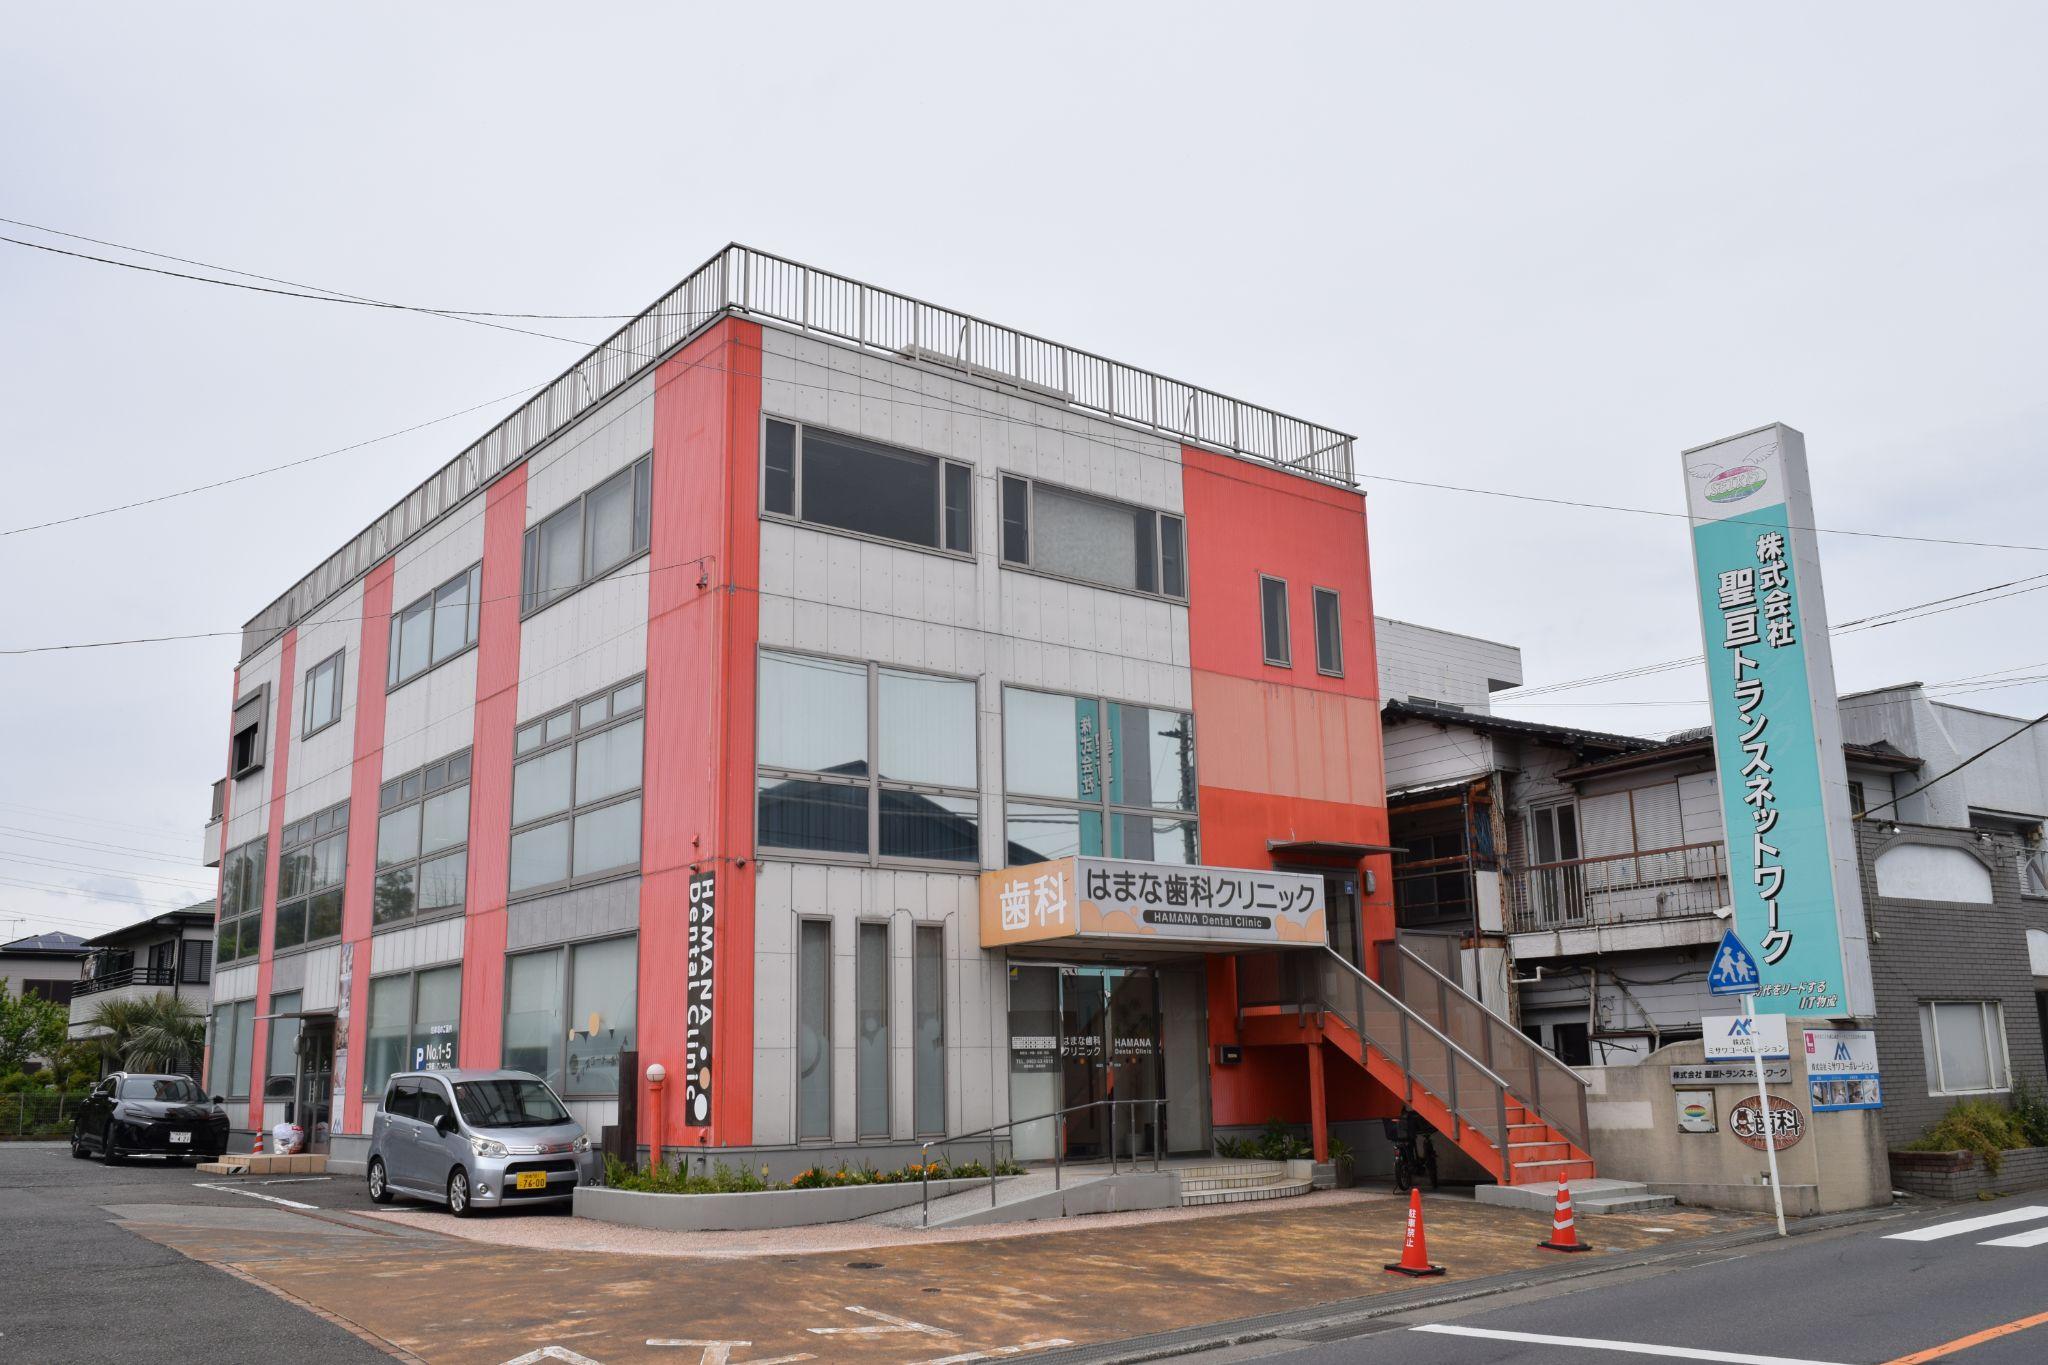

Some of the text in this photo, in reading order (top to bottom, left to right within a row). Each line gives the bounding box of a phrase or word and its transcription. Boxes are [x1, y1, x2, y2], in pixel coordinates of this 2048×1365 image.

[1756, 531, 1796, 649] 株式会社
[1000, 871, 1068, 932] 歯科
[1087, 868, 1316, 912] はまな歯科クリニック
[1154, 912, 1263, 928] HAMANA Dental Clinic
[699, 879, 714, 1026] HAMANA
[686, 882, 701, 1101] Dental Clinic
[1115, 1038, 1152, 1048] HAMANA
